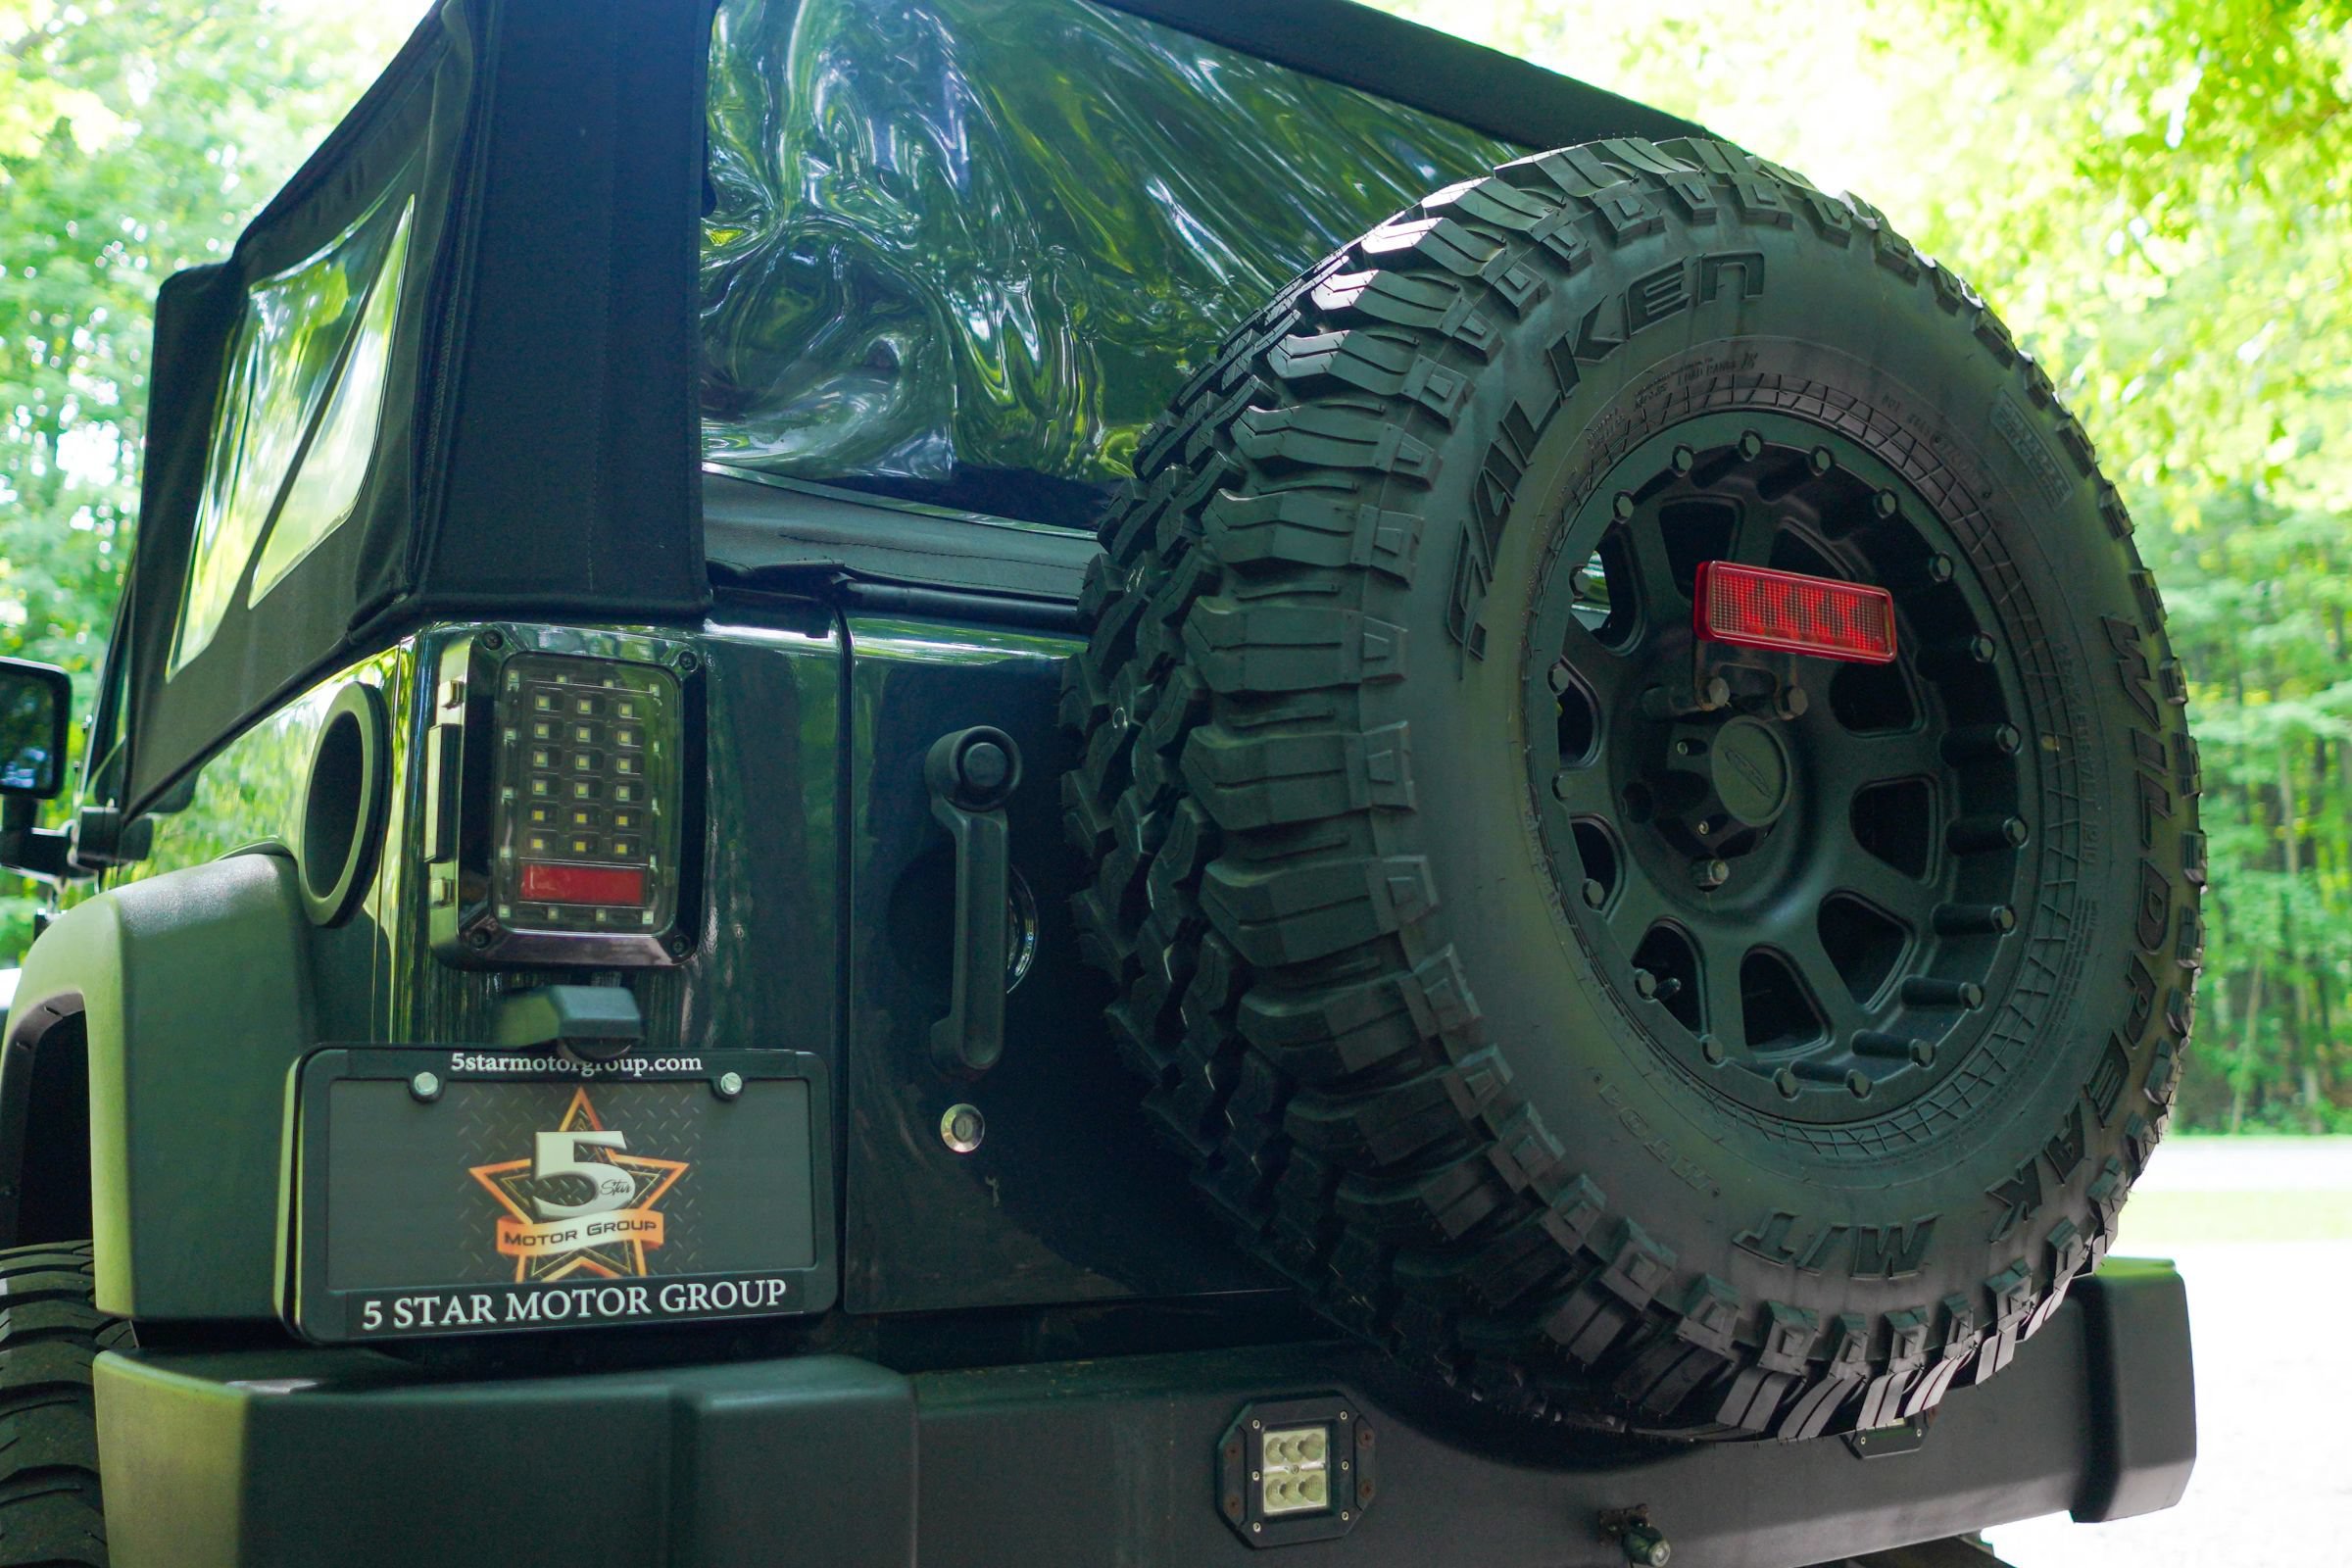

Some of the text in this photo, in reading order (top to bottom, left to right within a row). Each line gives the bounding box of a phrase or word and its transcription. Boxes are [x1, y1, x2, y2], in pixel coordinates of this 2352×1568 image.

[1984, 614, 2172, 1243] WILDPEAK
[532, 1130, 636, 1218] 5 Star
[1733, 1208, 1943, 1281] M/T
[362, 1278, 787, 1331] 5 STAR MOTOR GROUP
